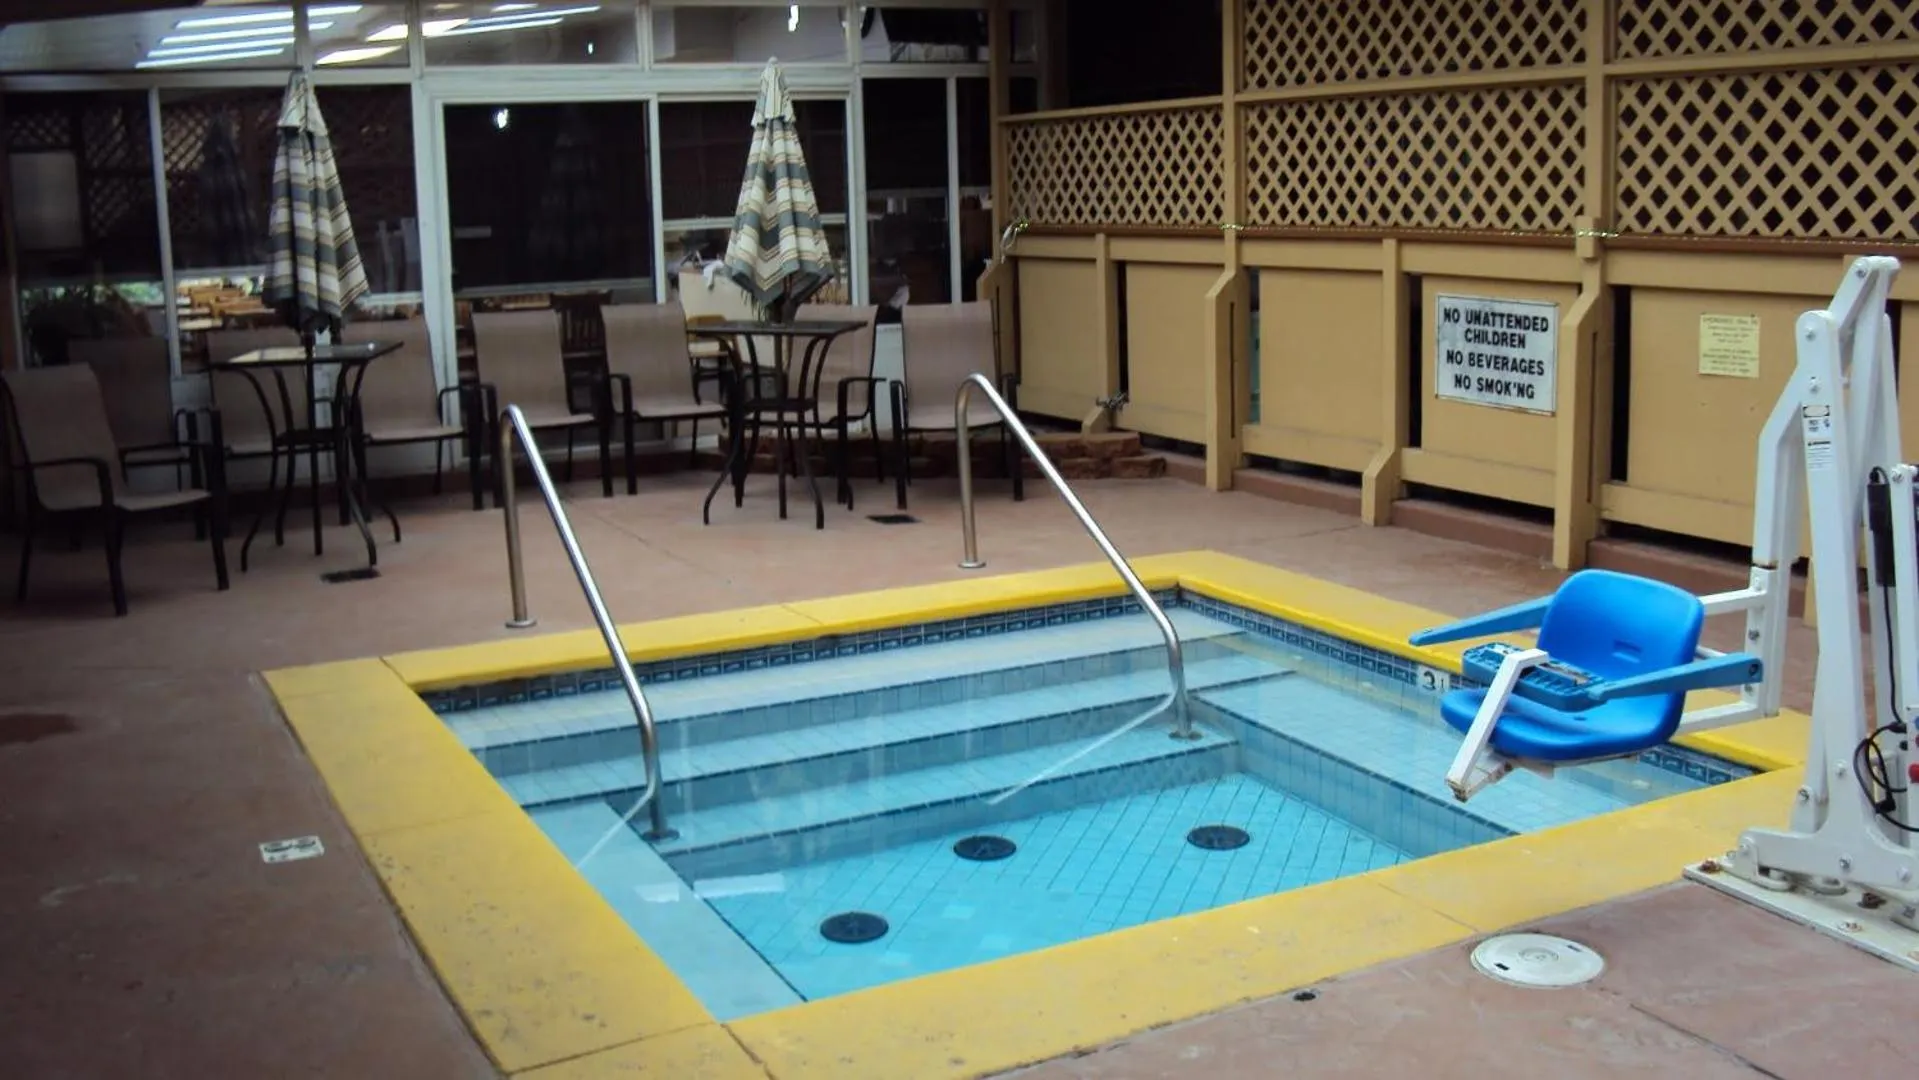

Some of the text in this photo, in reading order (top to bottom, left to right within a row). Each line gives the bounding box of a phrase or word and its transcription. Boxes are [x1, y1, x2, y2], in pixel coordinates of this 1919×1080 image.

[1443, 307, 1549, 332] NO UNATTENDED
[1464, 328, 1526, 349] CHILDREN
[1446, 349, 1544, 376] NO BEVERAGES
[1454, 373, 1471, 390] NO
